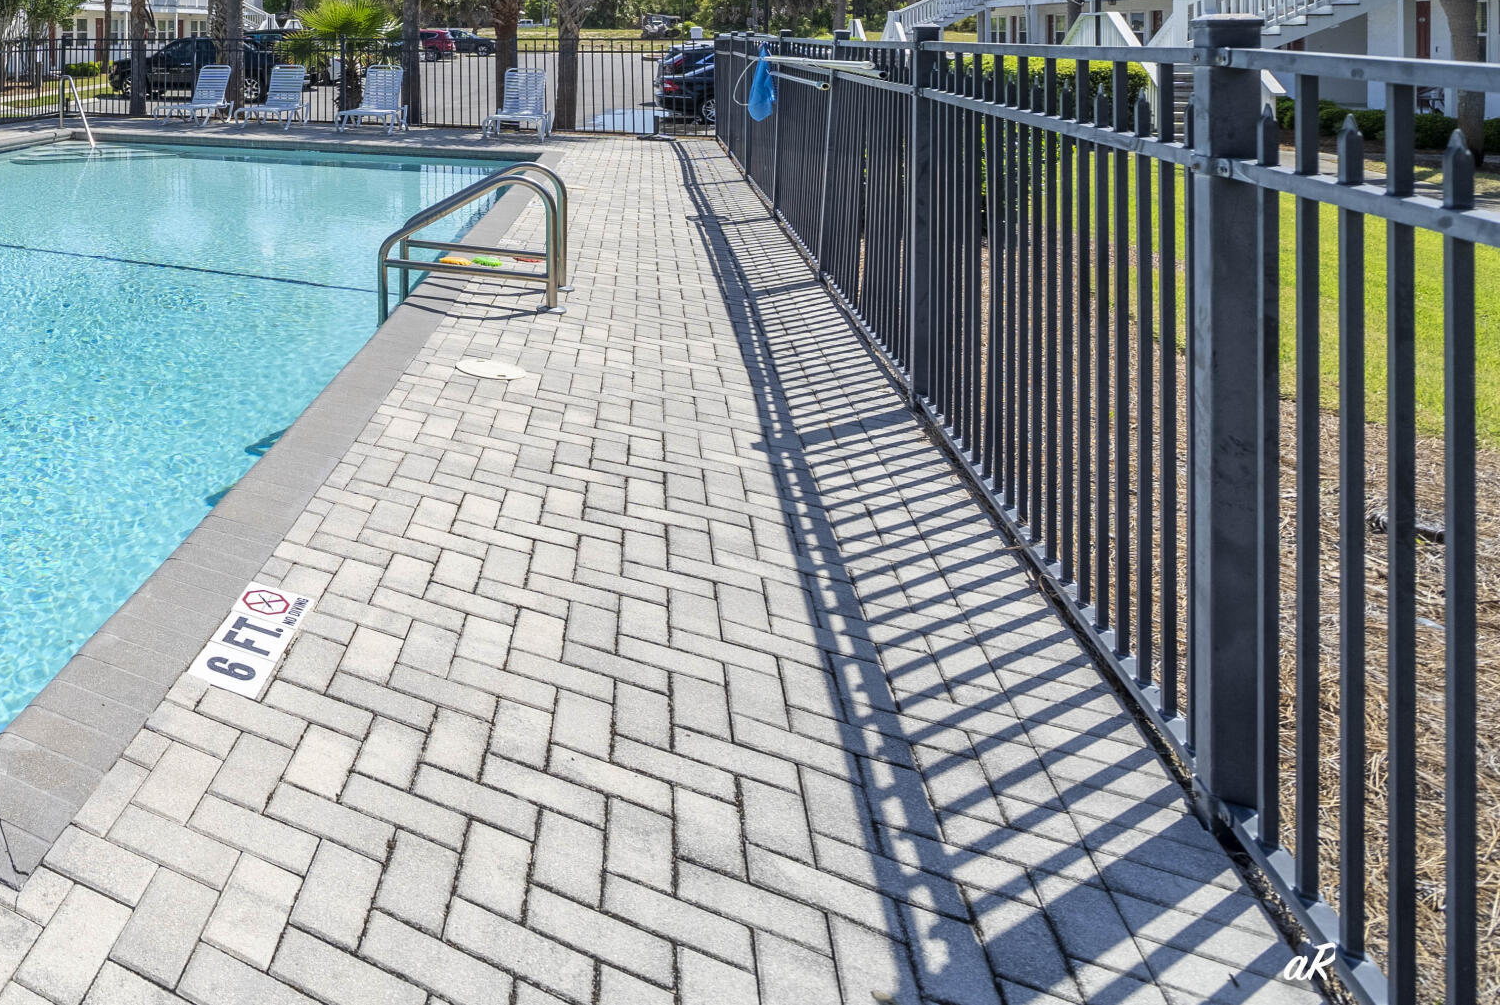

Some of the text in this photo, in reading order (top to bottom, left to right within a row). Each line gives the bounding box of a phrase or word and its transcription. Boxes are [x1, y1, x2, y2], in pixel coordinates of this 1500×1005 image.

[282, 597, 309, 627] NO DIVING
[206, 656, 257, 682] 6
